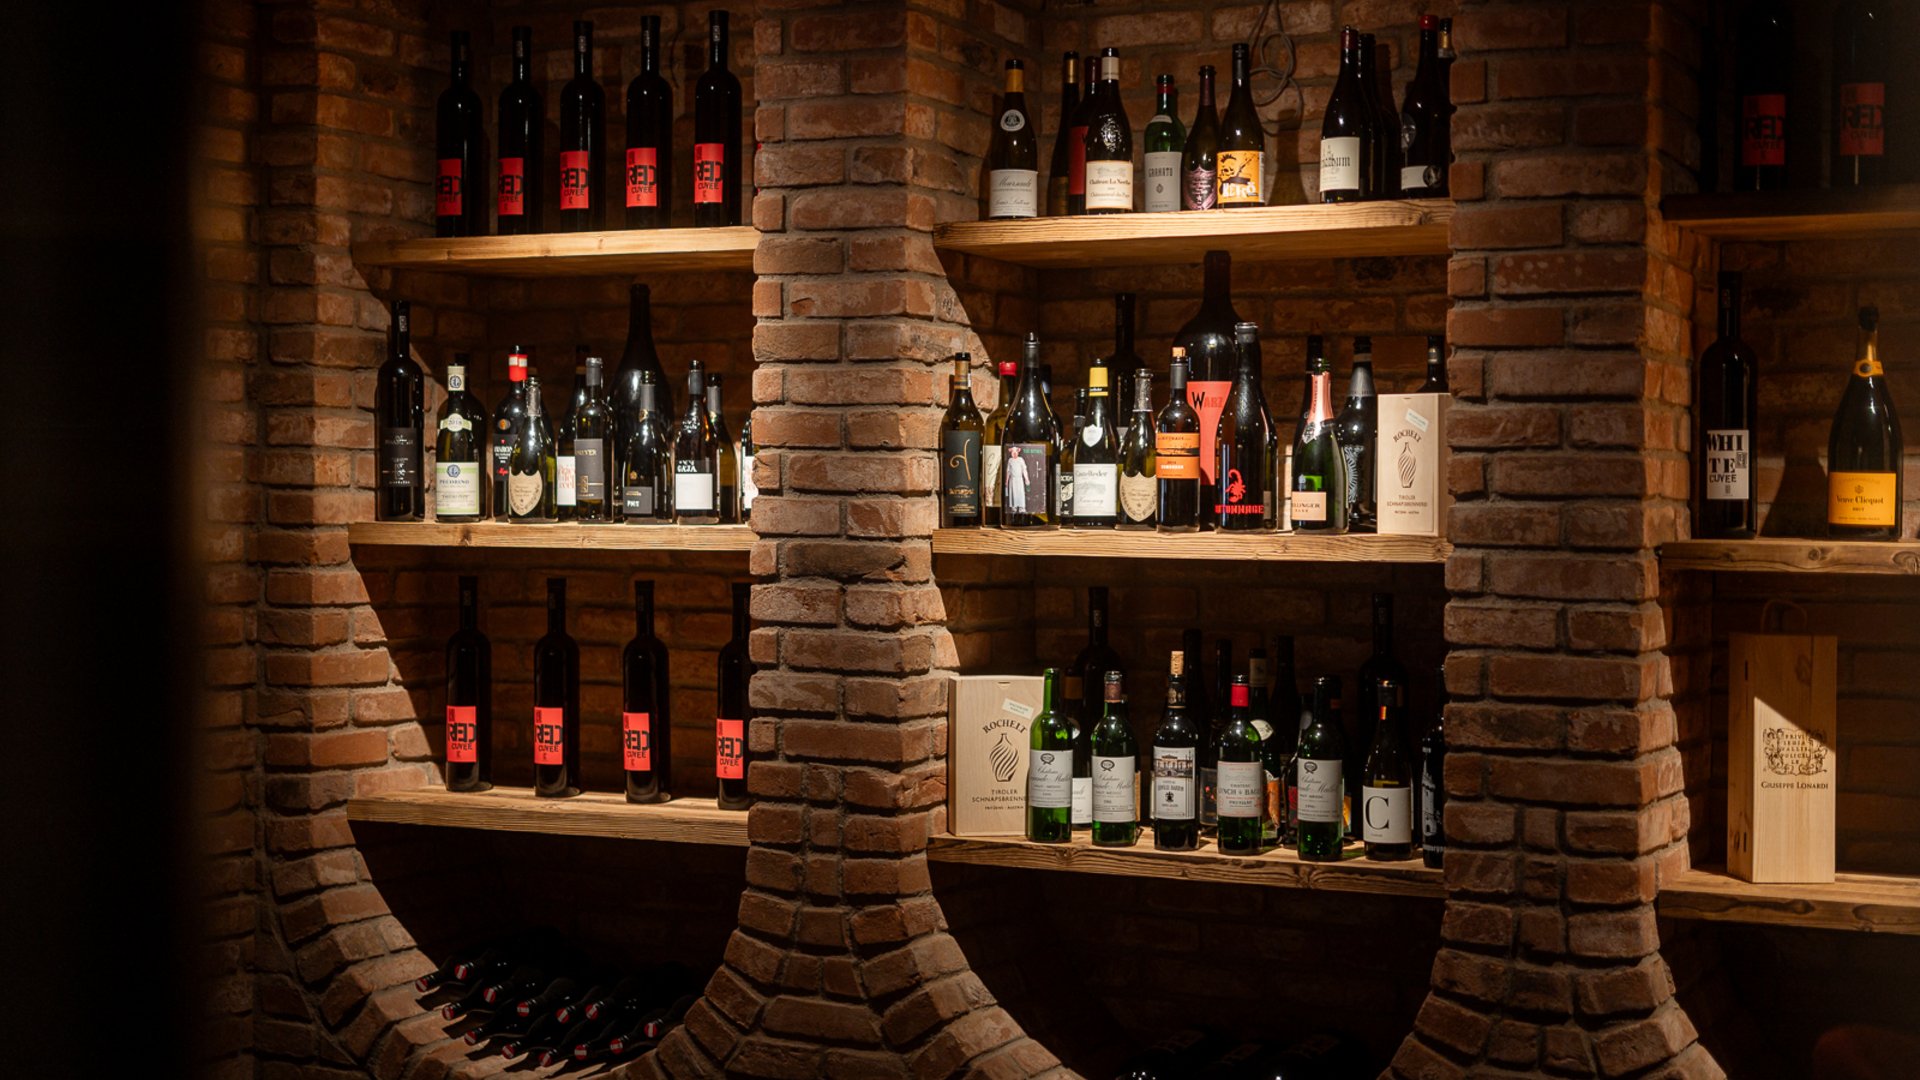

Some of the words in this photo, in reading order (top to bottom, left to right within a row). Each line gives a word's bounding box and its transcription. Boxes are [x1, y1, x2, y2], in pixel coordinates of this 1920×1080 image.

[561, 168, 589, 188] RED
[628, 164, 657, 185] RED
[696, 160, 723, 182] RED
[1707, 434, 1744, 451] WHI
[677, 464, 698, 473] GAJA
[1709, 458, 1735, 474] TE
[1709, 474, 1737, 484] CUVEE
[449, 722, 477, 743] RED
[536, 724, 563, 745] RED
[982, 719, 1028, 734] ROCHELT
[624, 729, 650, 751] RED
[718, 736, 744, 758] RED
[1365, 795, 1390, 831] C
